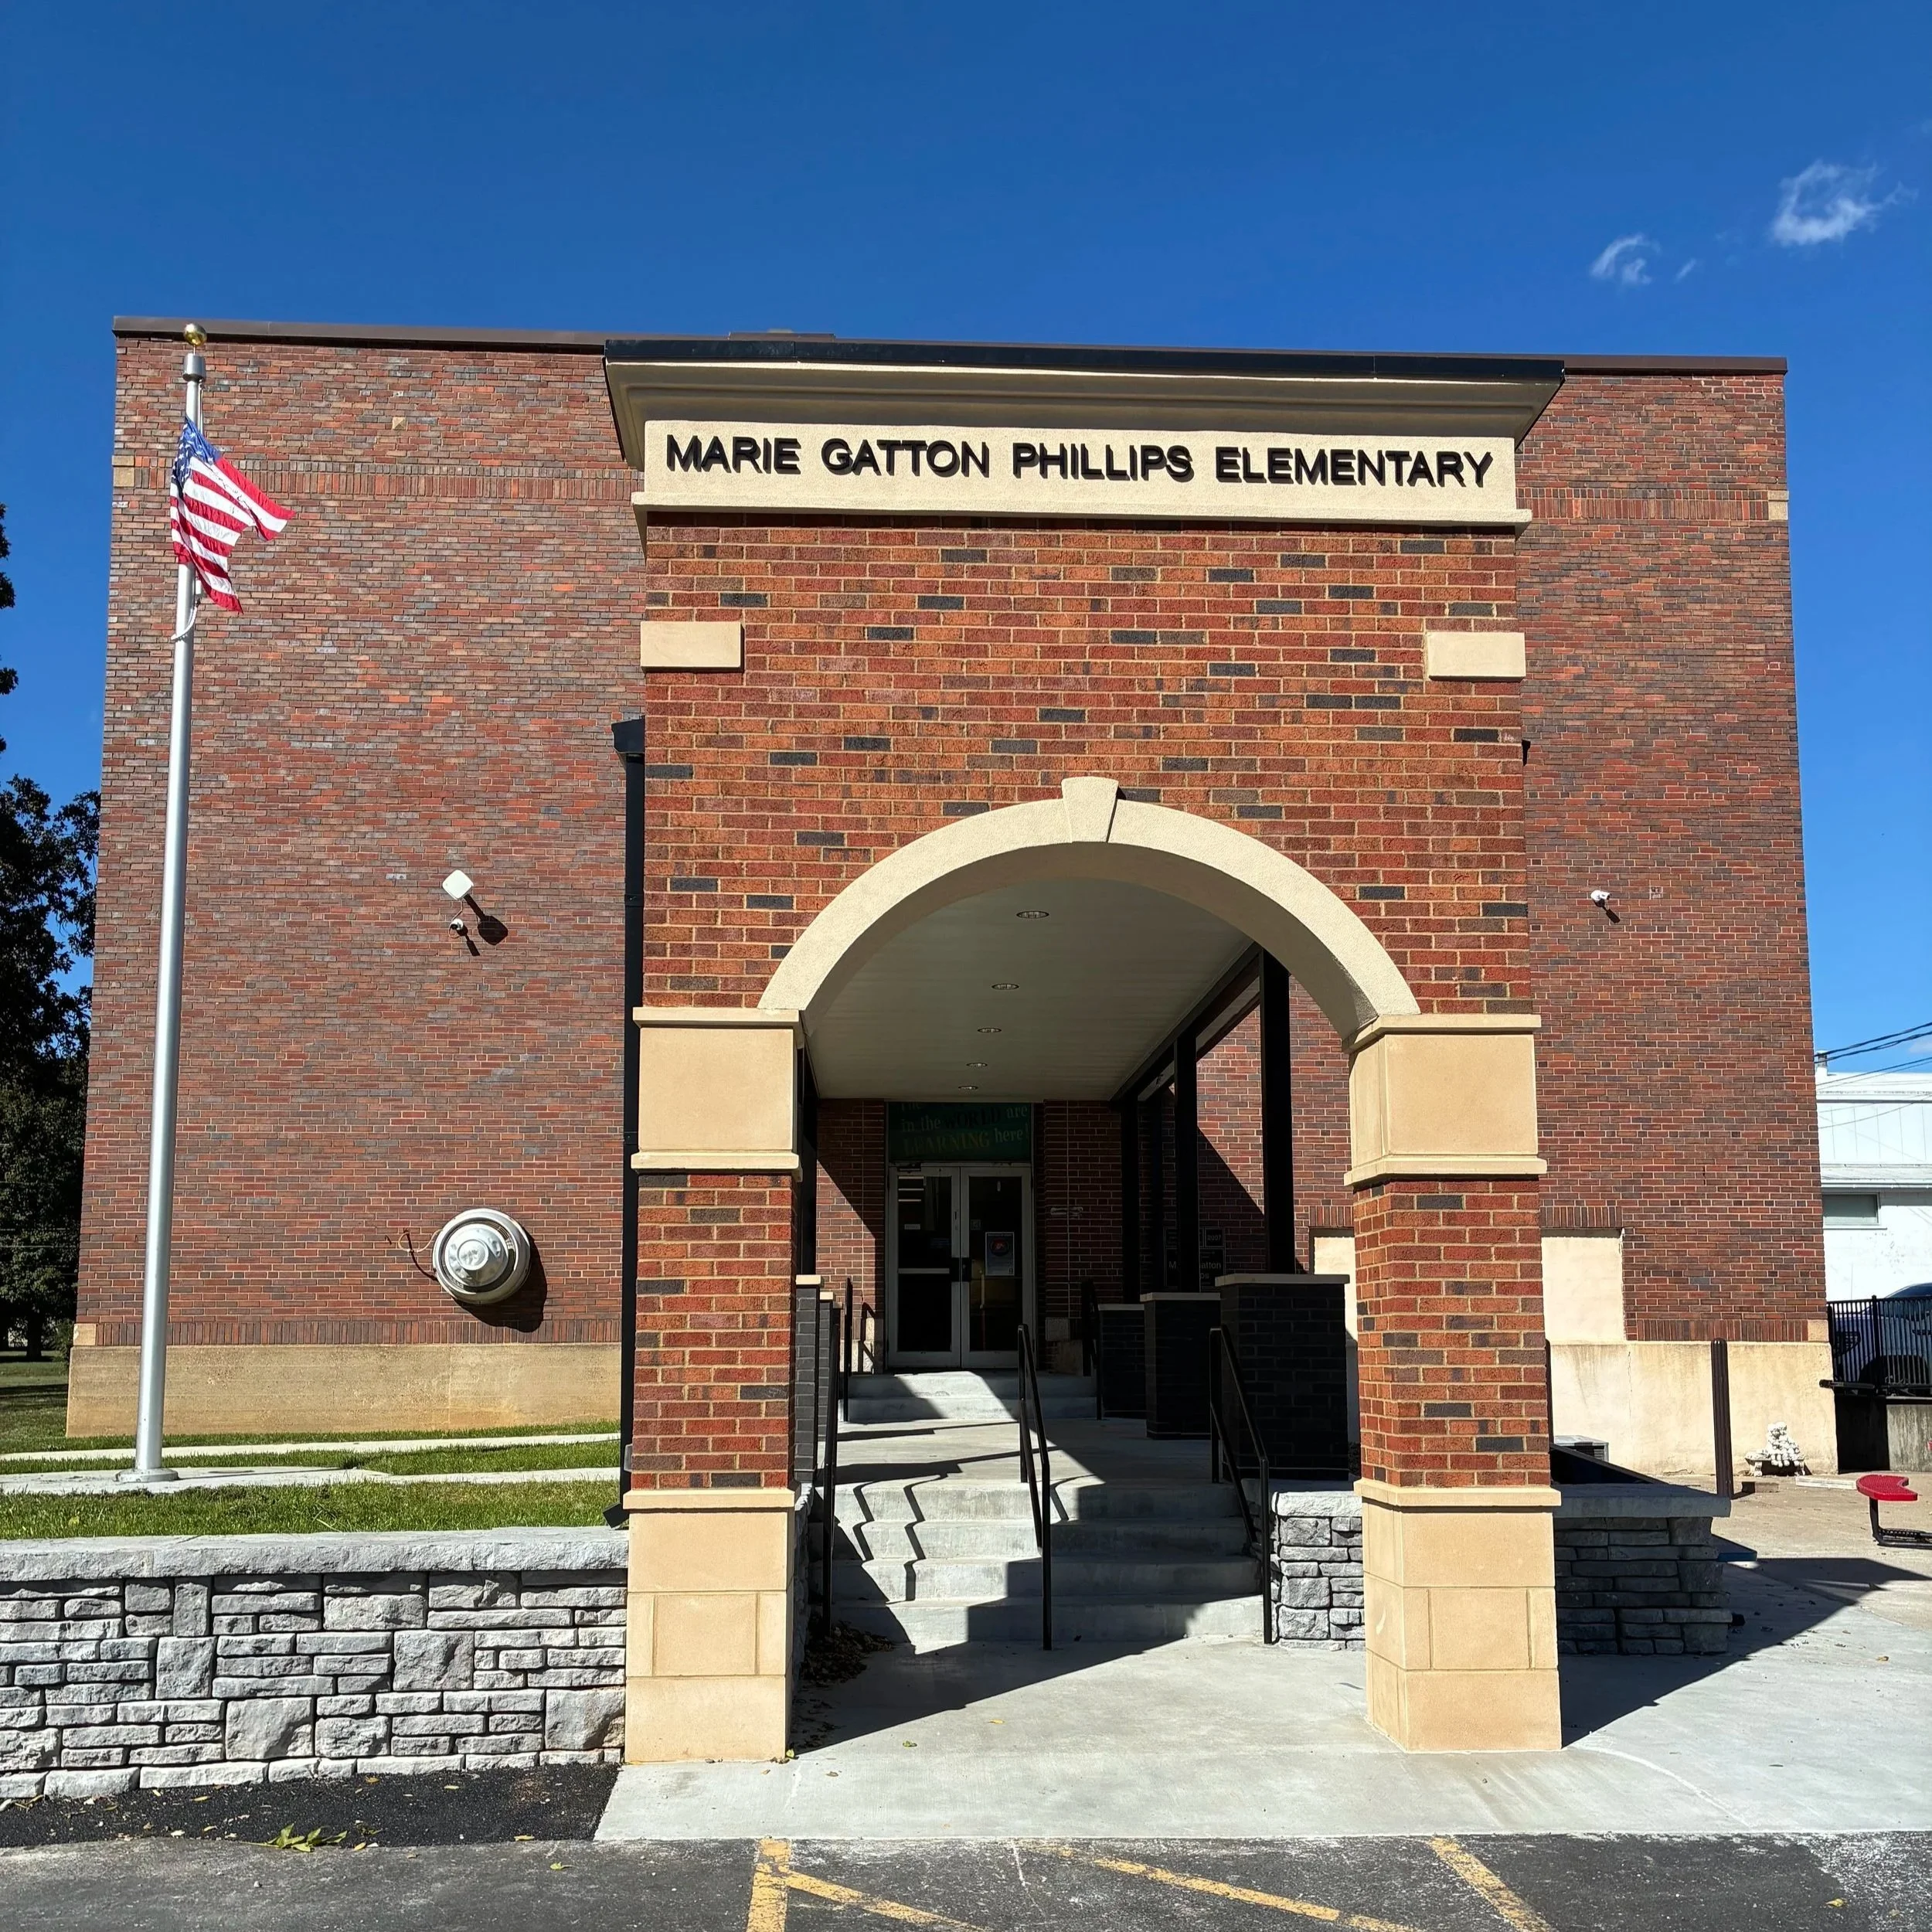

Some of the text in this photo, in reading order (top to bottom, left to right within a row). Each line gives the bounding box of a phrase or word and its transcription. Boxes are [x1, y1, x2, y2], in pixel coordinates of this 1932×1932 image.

[666, 434, 1494, 487] MARIE GATTON PHILLIPS ELEMENTARY
[901, 1119, 915, 1132] in
[920, 1114, 940, 1131] the
[1006, 1106, 1028, 1119] are
[903, 1131, 990, 1156] LEARNING
[1200, 1261, 1221, 1270] atton
